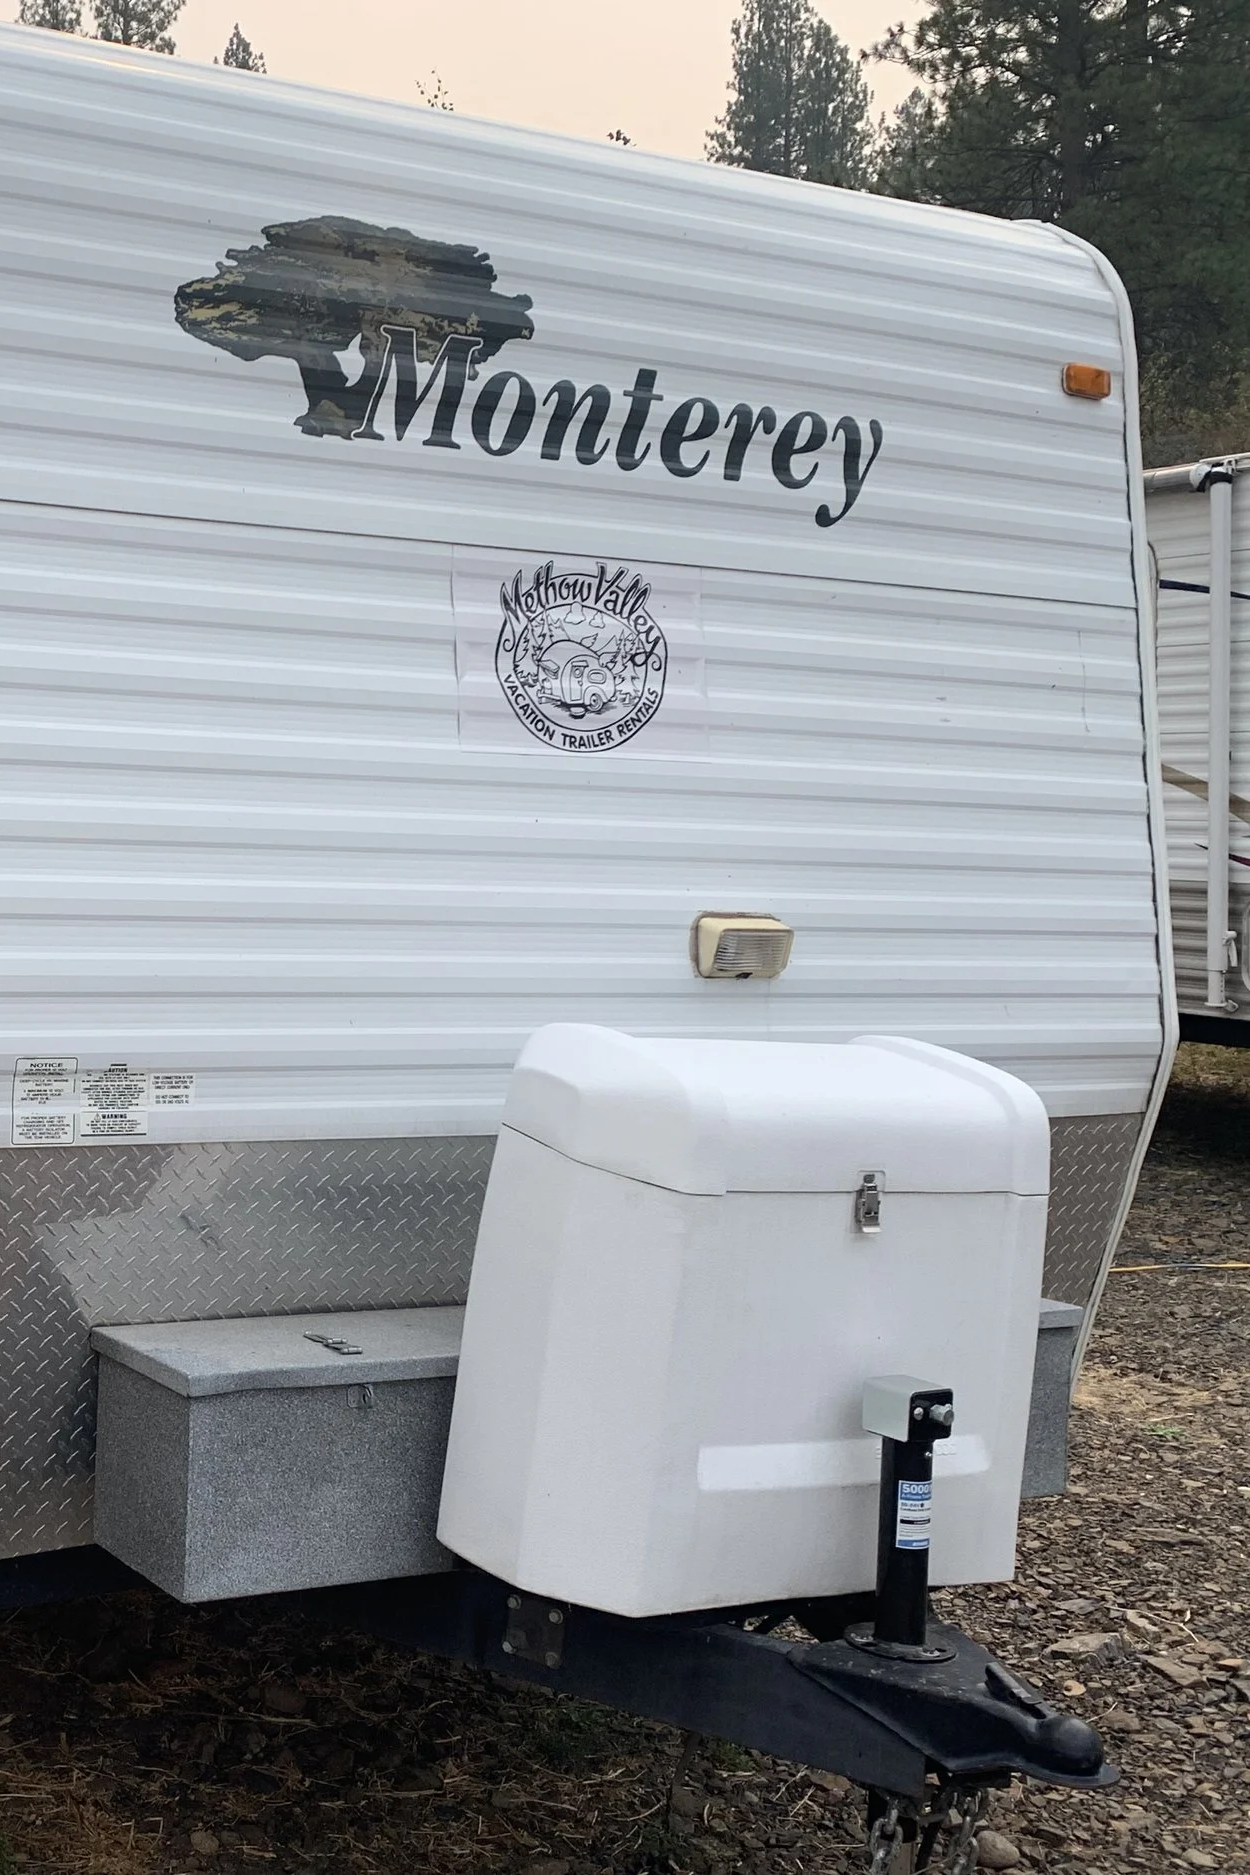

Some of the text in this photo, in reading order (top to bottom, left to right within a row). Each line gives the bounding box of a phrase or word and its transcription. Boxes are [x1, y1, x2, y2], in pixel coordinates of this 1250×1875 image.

[353, 324, 883, 528] Monterey
[500, 560, 661, 672] Methow Valley
[503, 674, 660, 749] VACATION TRAILER RENTALS
